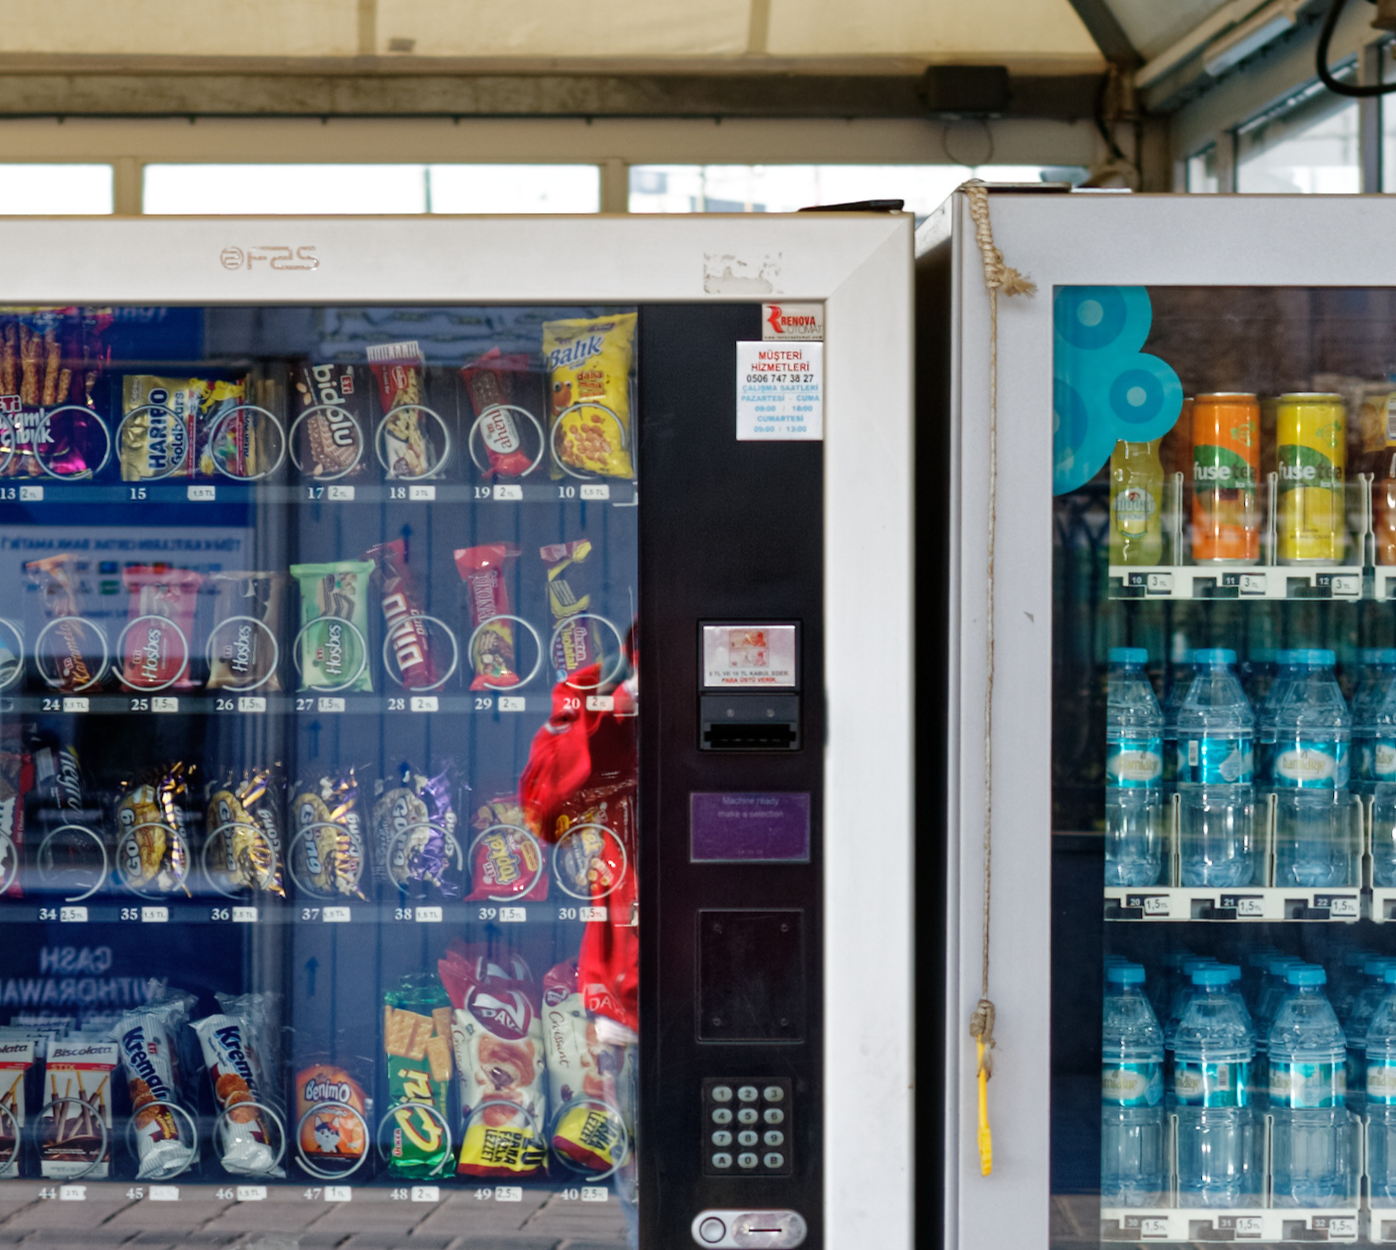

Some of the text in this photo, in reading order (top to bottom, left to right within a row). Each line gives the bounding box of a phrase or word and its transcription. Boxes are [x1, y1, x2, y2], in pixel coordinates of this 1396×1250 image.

[781, 316, 815, 326] RENOVA
[759, 350, 802, 361] MÜŞTERİ
[752, 362, 810, 372] HİZMETLERİ
[746, 374, 814, 383] 0506 747 38 27
[742, 384, 819, 393] ÇALIŞMA SAATLERİ
[757, 414, 804, 422] CUMARTESİ
[147, 387, 169, 470] HARIBO
[1193, 462, 1230, 481] fuse
[1278, 462, 1315, 481] fuse
[0, 488, 16, 500] 13
[130, 488, 146, 500] 15
[307, 488, 324, 499] 17
[131, 698, 148, 710] 25
[296, 698, 313, 710] 27
[387, 698, 405, 710] 28
[121, 908, 138, 920] 35
[301, 908, 319, 920] 37
[479, 908, 496, 919] 39
[54, 1045, 113, 1058] Biscolata
[304, 1188, 321, 1199] 47
